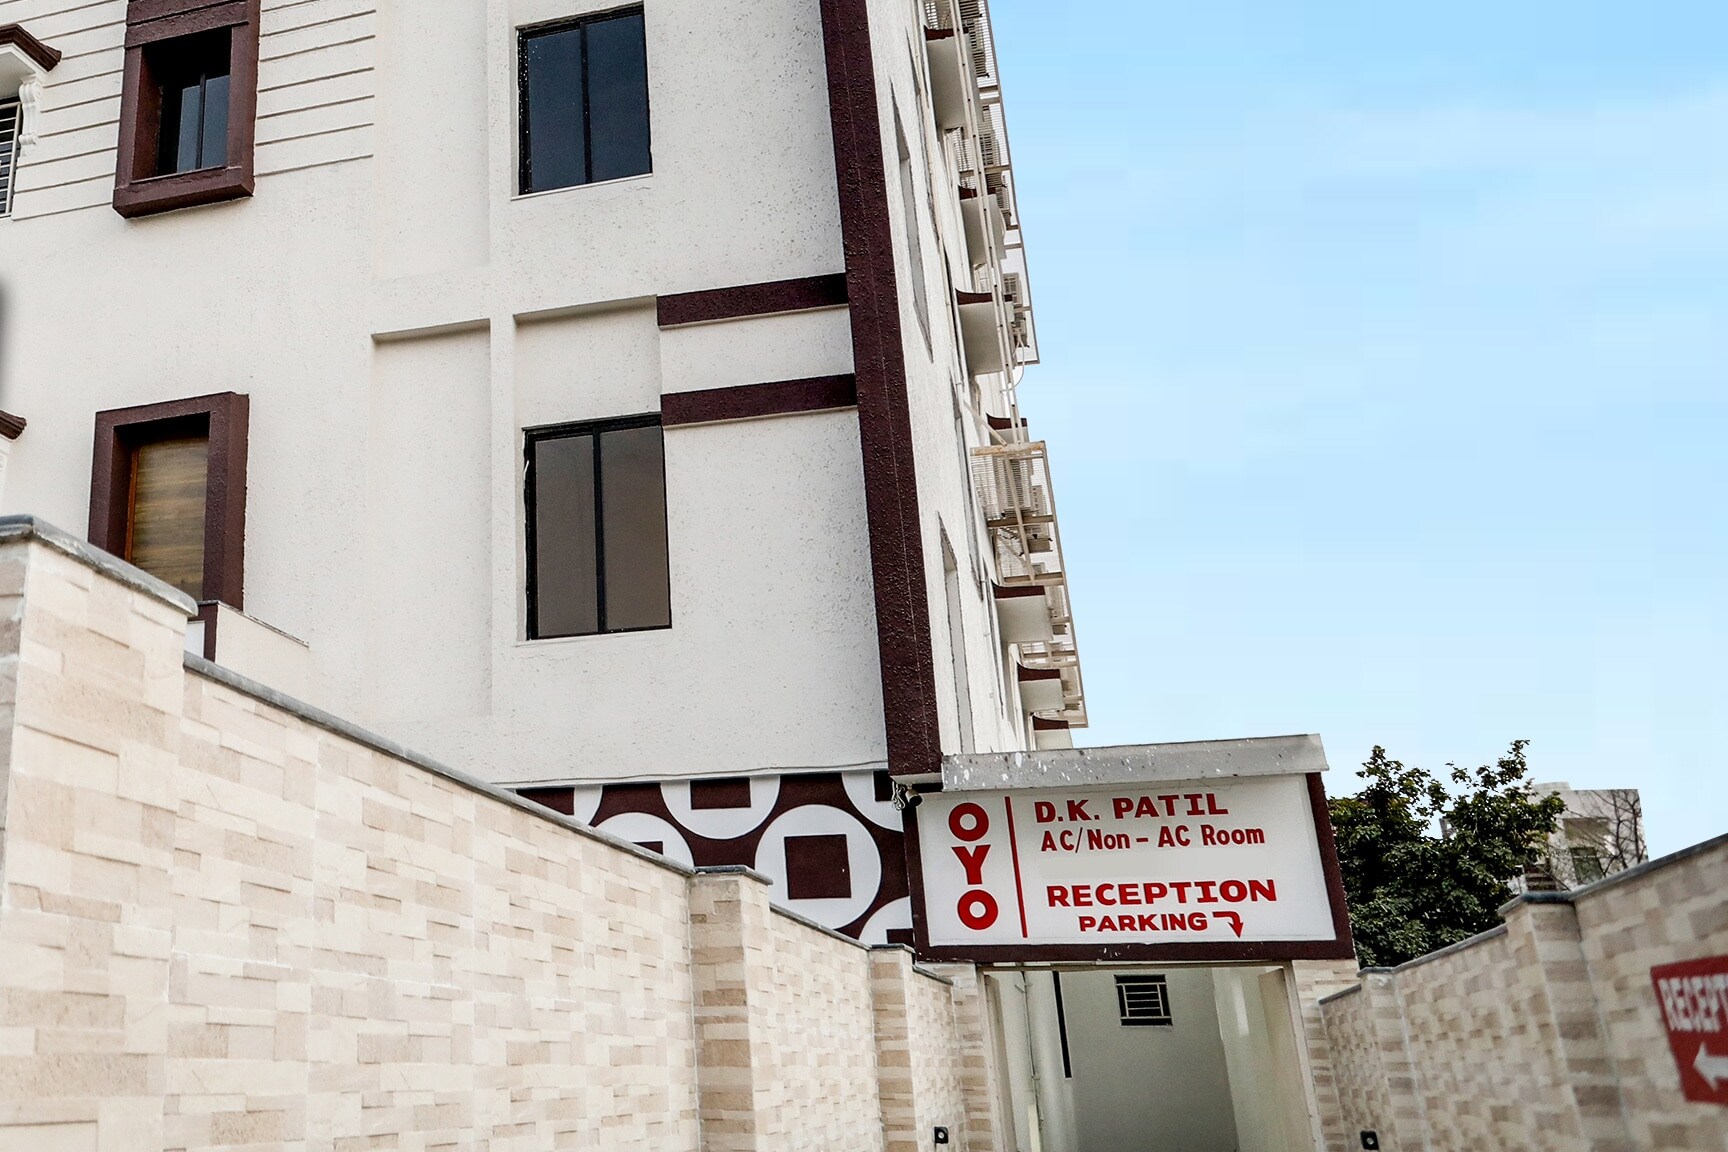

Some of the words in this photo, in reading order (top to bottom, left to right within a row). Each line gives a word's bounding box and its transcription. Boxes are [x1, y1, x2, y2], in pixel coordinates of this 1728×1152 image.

[1034, 799, 1100, 822] D.K.
[1112, 793, 1229, 820] PATIL
[1158, 825, 1191, 848] AC
[1201, 824, 1265, 846] Room
[948, 802, 999, 930] OYO
[1046, 879, 1278, 907] RECEPTION
[1078, 912, 1208, 933] PARKING
